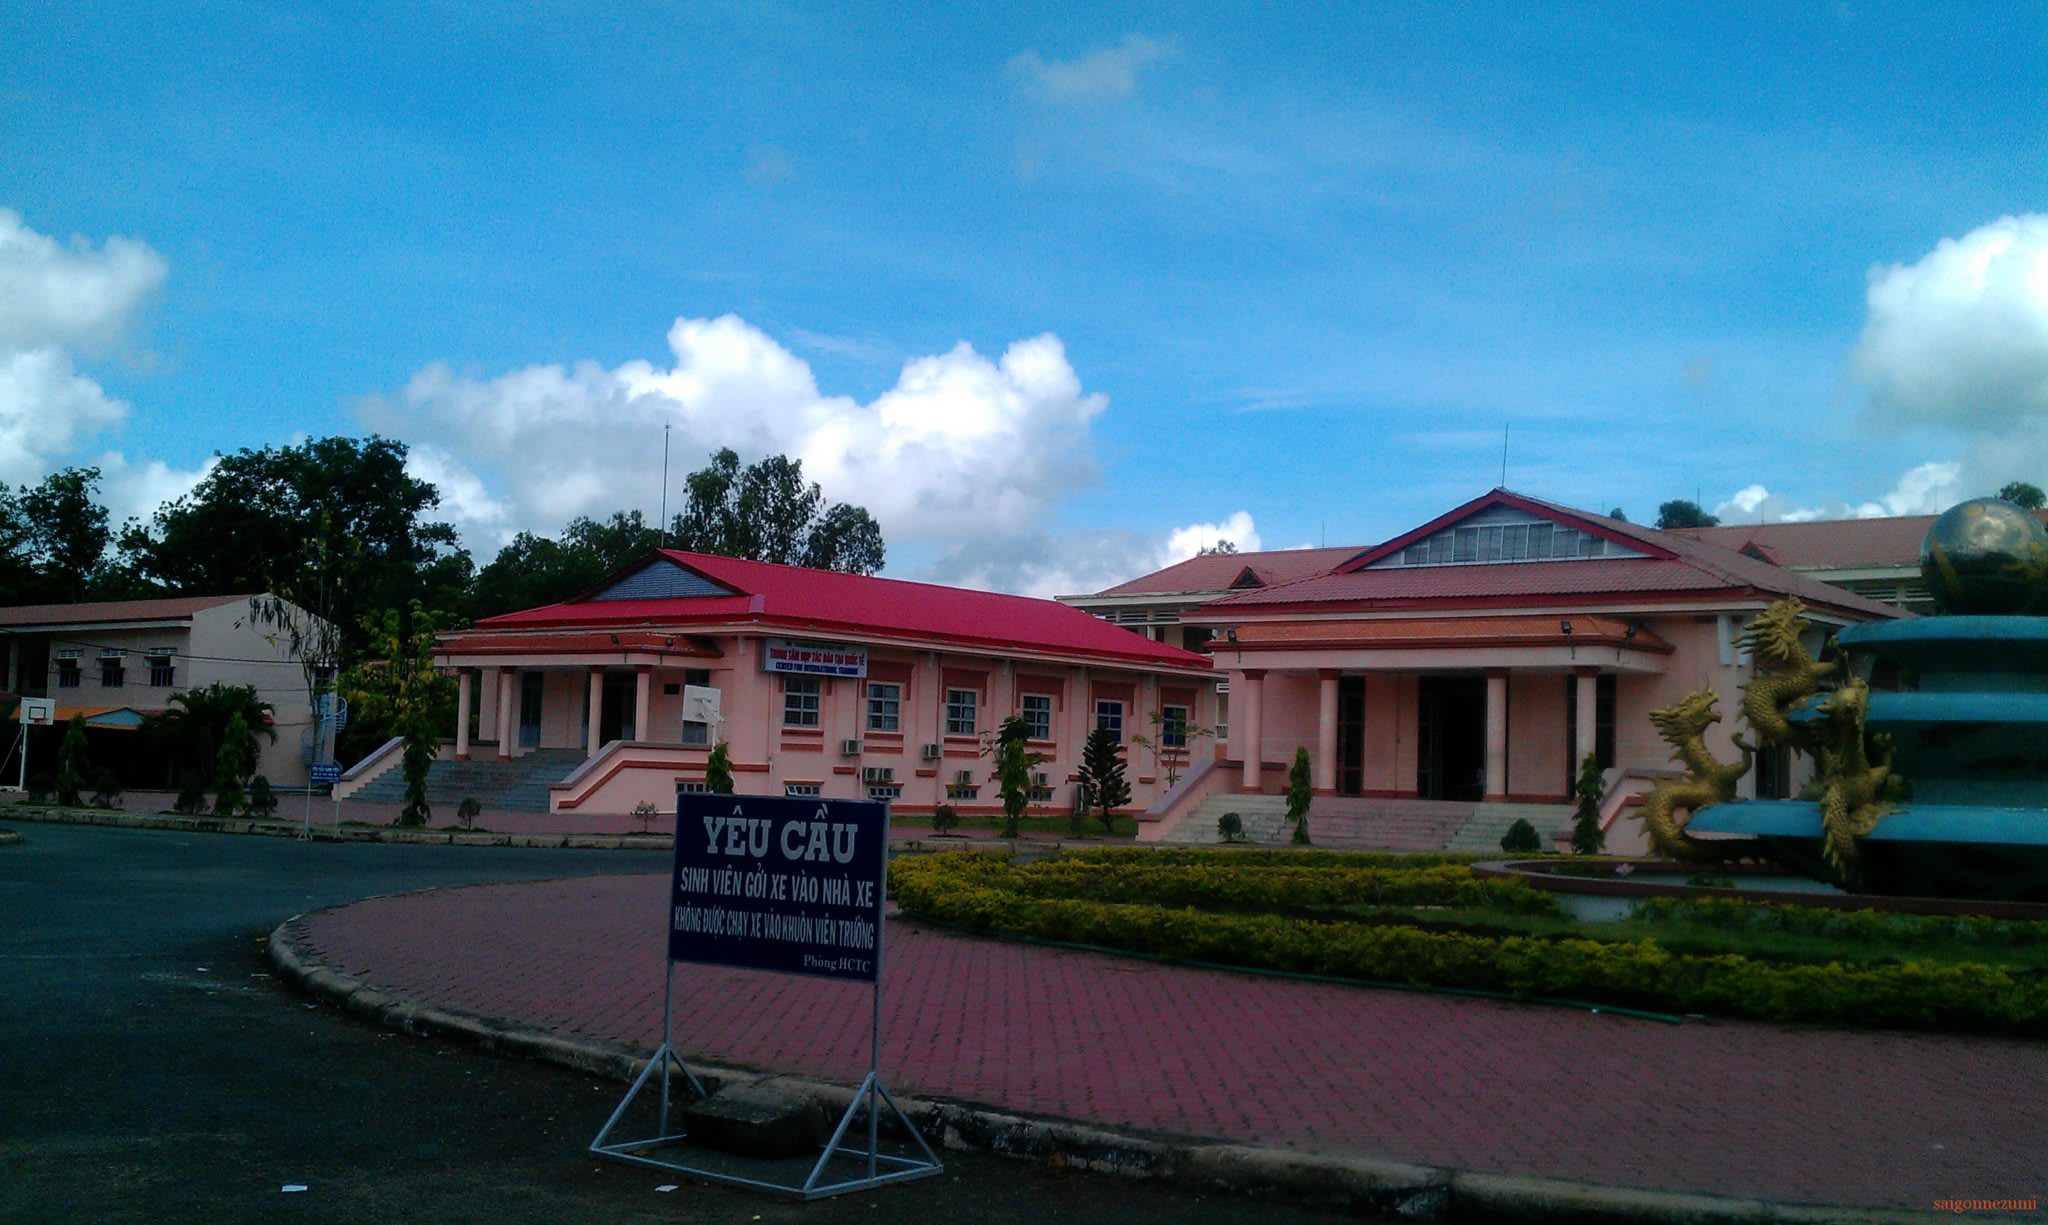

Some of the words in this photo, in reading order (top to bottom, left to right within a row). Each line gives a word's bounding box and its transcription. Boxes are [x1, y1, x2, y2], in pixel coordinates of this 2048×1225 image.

[703, 805, 772, 858] YÊU
[780, 803, 858, 863] CẦU
[680, 867, 708, 893] SINH
[713, 864, 743, 897] VIÊN
[769, 874, 788, 900] XE
[792, 869, 818, 904] VÀO
[822, 874, 851, 906] NHÀ
[855, 880, 874, 908] XE
[674, 902, 701, 932] KHÔNG
[727, 909, 750, 941] CHẠY
[750, 912, 762, 938] XE
[764, 907, 781, 940] VÀO
[782, 911, 813, 944] KHUÔN
[815, 912, 836, 947] VIÊN
[838, 914, 874, 950] TRƯỜNG
[803, 954, 838, 970] Phòng
[838, 956, 870, 973] HCTC
